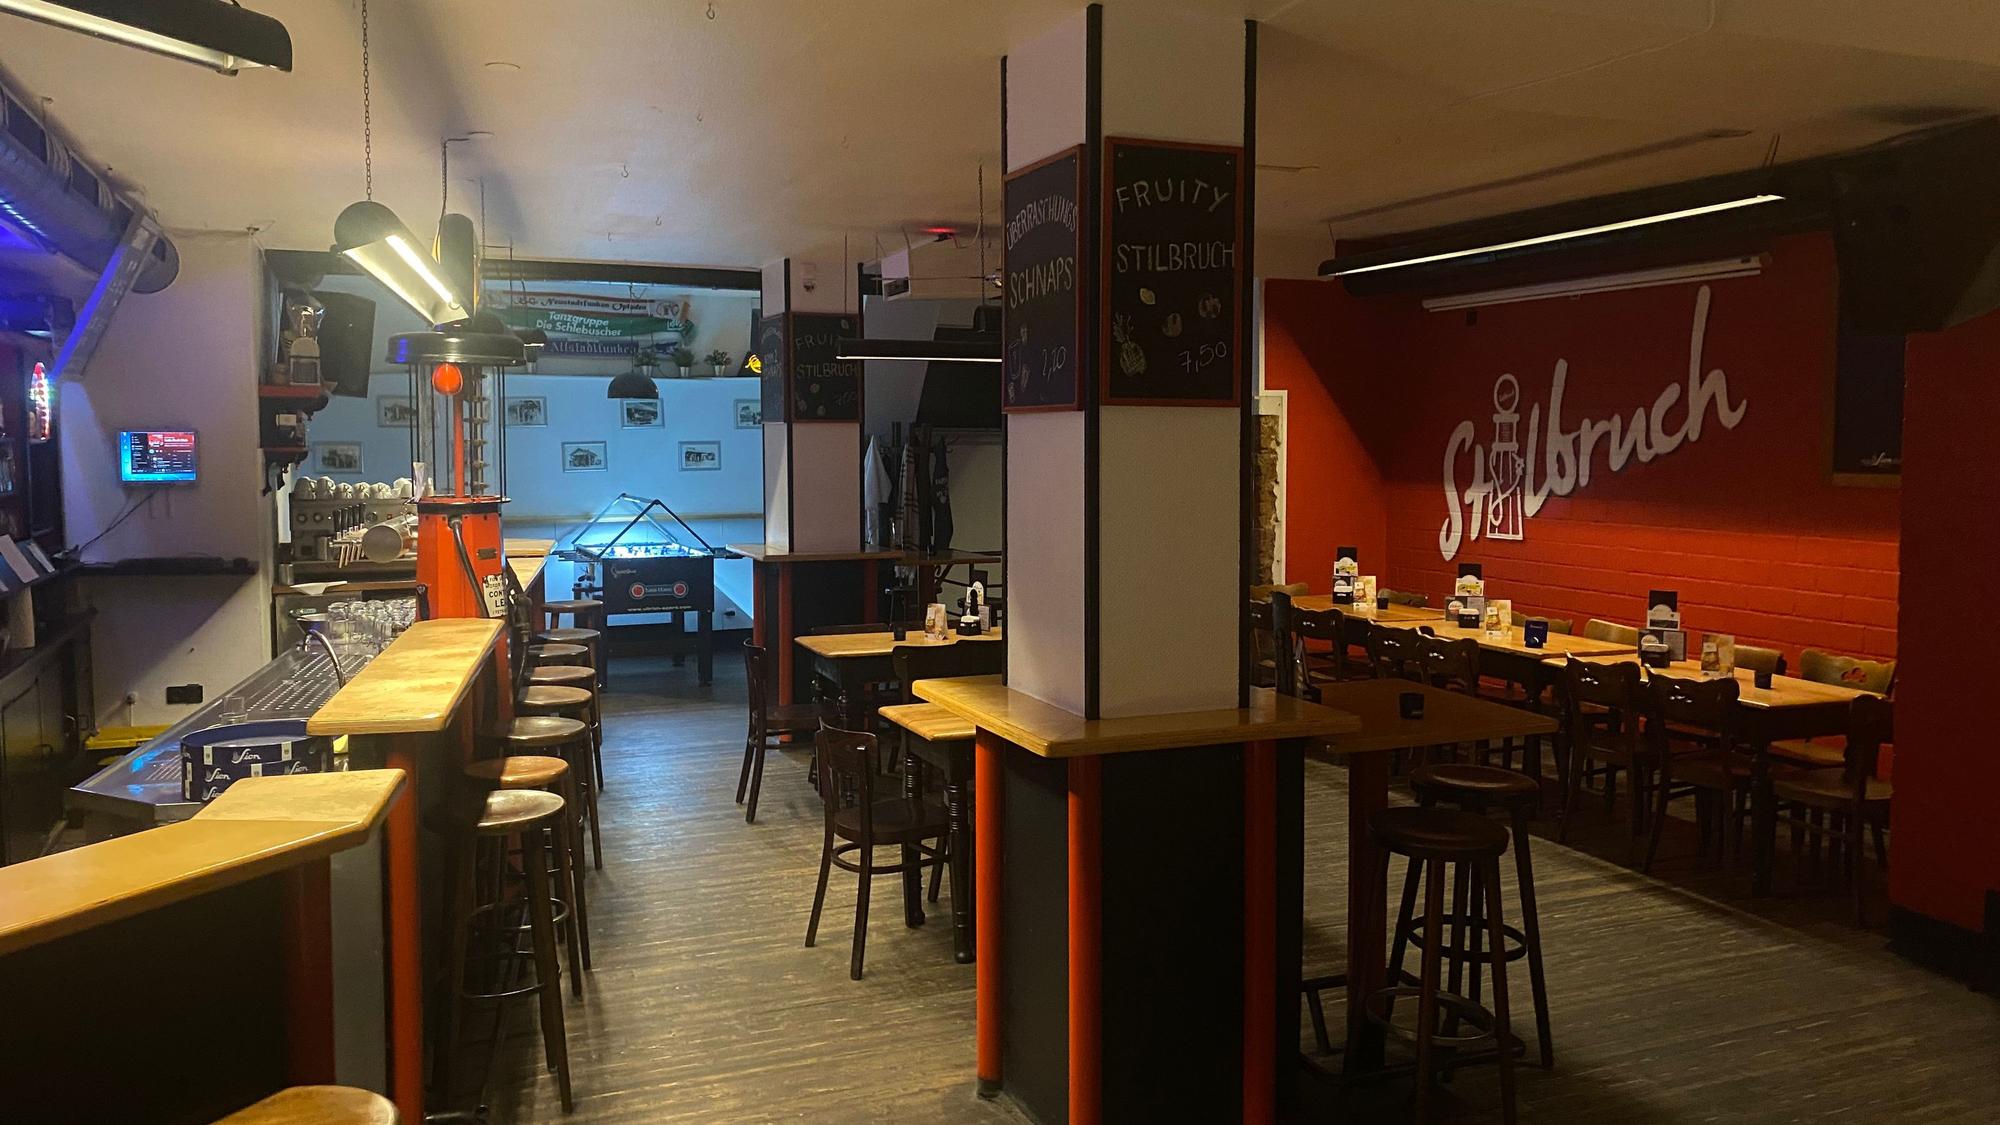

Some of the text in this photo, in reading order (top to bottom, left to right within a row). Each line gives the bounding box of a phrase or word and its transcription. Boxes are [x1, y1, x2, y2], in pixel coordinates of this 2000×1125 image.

[1116, 177, 1230, 214] FRUITY
[1116, 241, 1235, 273] STILBRUCH
[1010, 257, 1074, 309] SCHNAPS
[549, 311, 609, 327] Tanzgruppe
[536, 319, 622, 336] Die Schlebuscher
[795, 332, 835, 350] FRUI
[1178, 340, 1228, 374] 7,50
[796, 362, 861, 378] STILBRUCH
[489, 590, 504, 598] CON
[495, 599, 504, 608] LE
[231, 748, 262, 764] Sion
[205, 767, 231, 783] Sion
